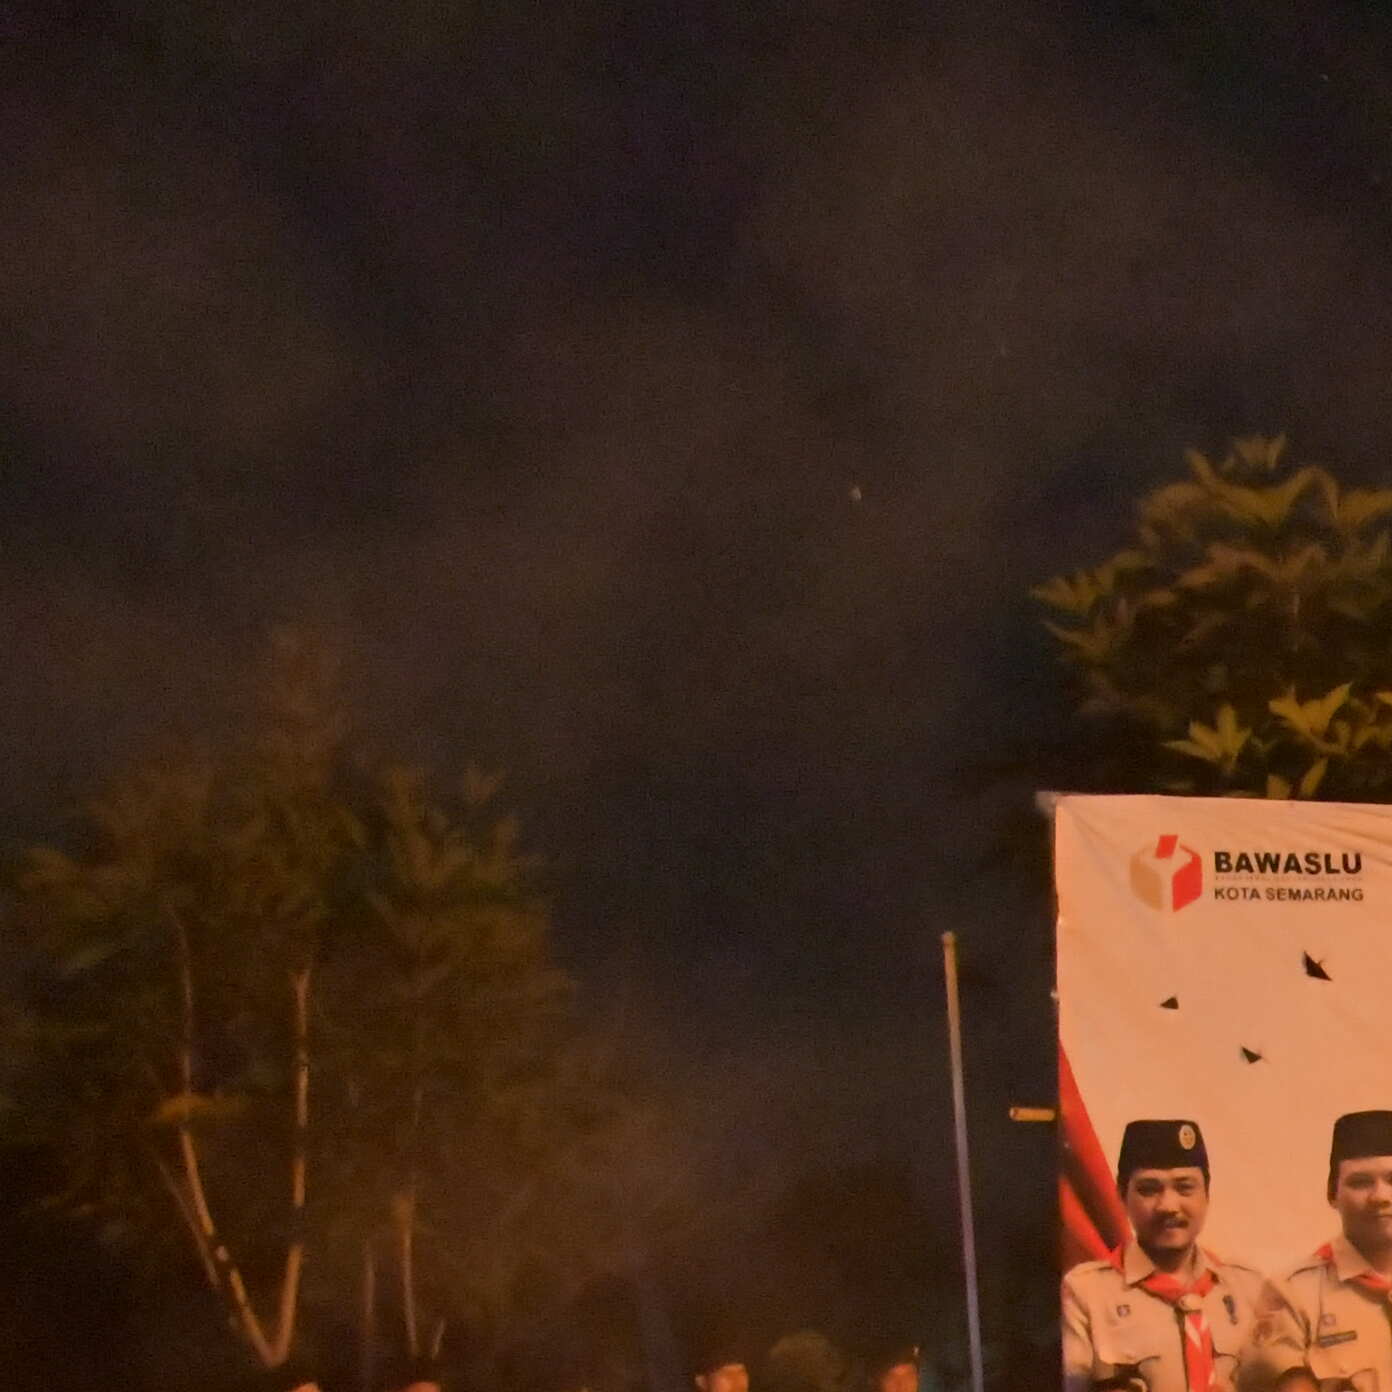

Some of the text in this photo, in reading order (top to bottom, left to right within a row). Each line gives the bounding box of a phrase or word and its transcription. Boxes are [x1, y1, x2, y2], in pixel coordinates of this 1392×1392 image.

[1213, 851, 1363, 875] BAWASLU
[1214, 887, 1364, 902] KOTA SEMARANG
